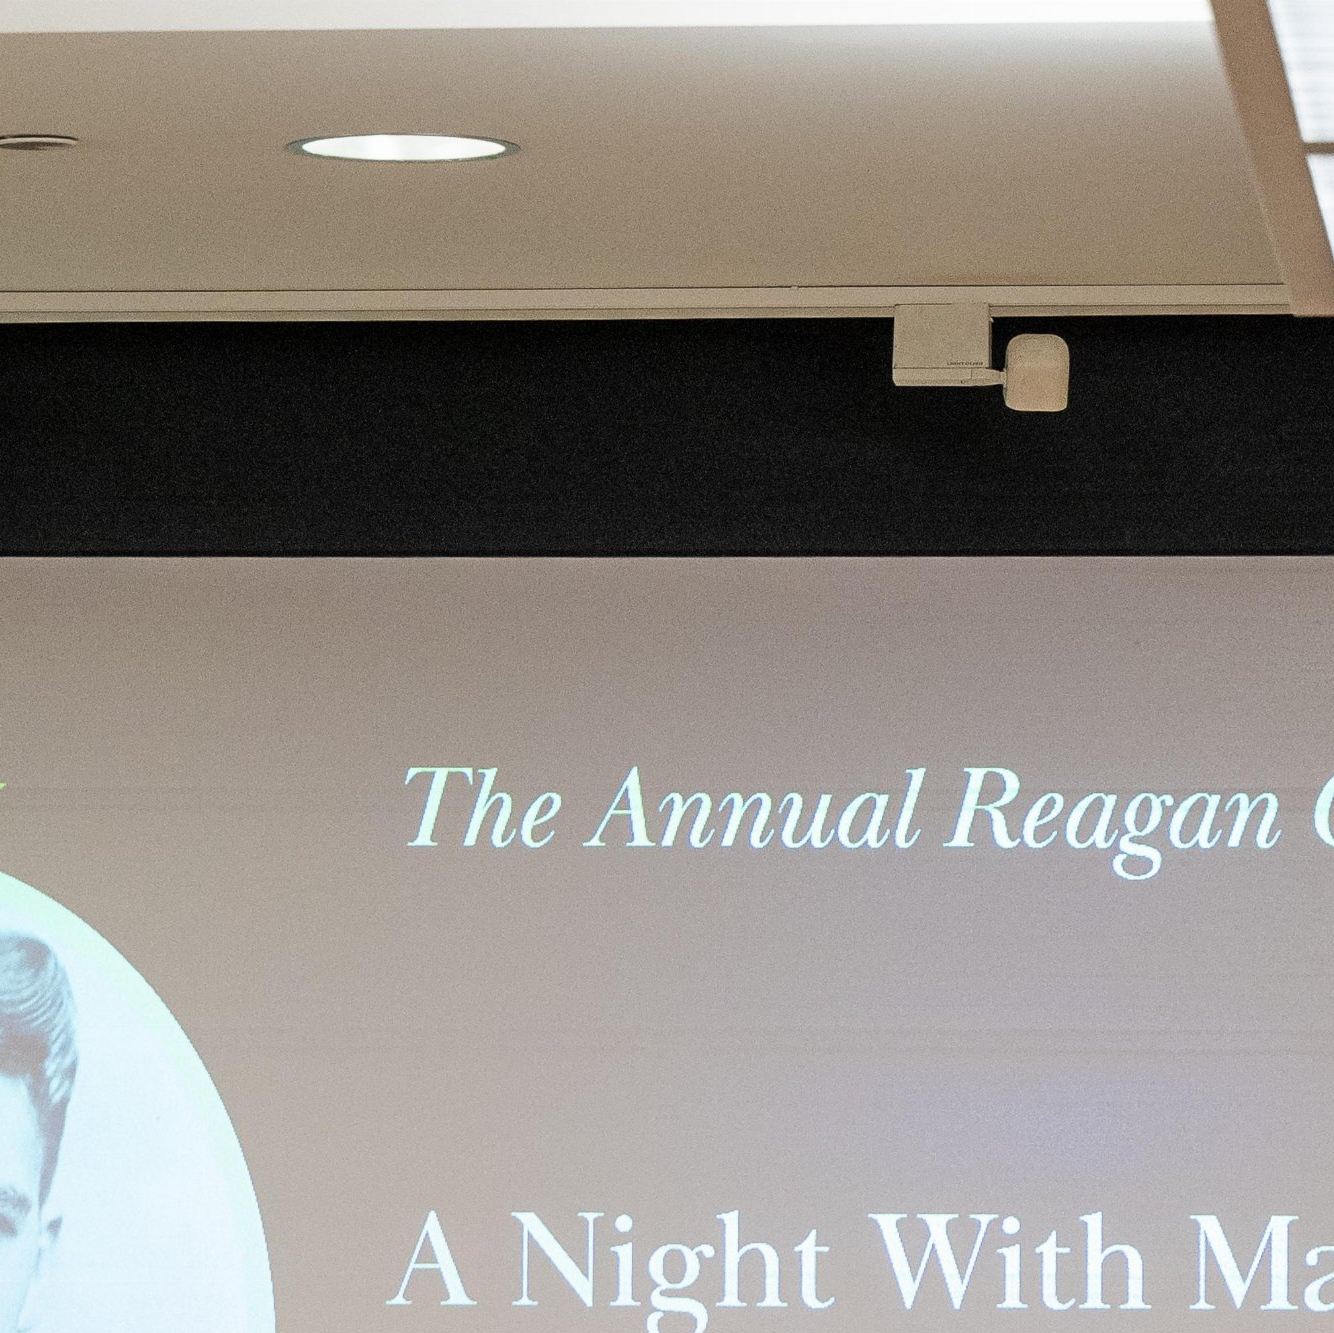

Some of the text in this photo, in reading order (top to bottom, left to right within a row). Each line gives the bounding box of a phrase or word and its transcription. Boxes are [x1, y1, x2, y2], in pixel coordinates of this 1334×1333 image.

[404, 766, 563, 849] The
[582, 765, 927, 849] Annual
[942, 766, 1282, 881] Reagan
[386, 1210, 476, 1306] A
[868, 1211, 1152, 1311] With
